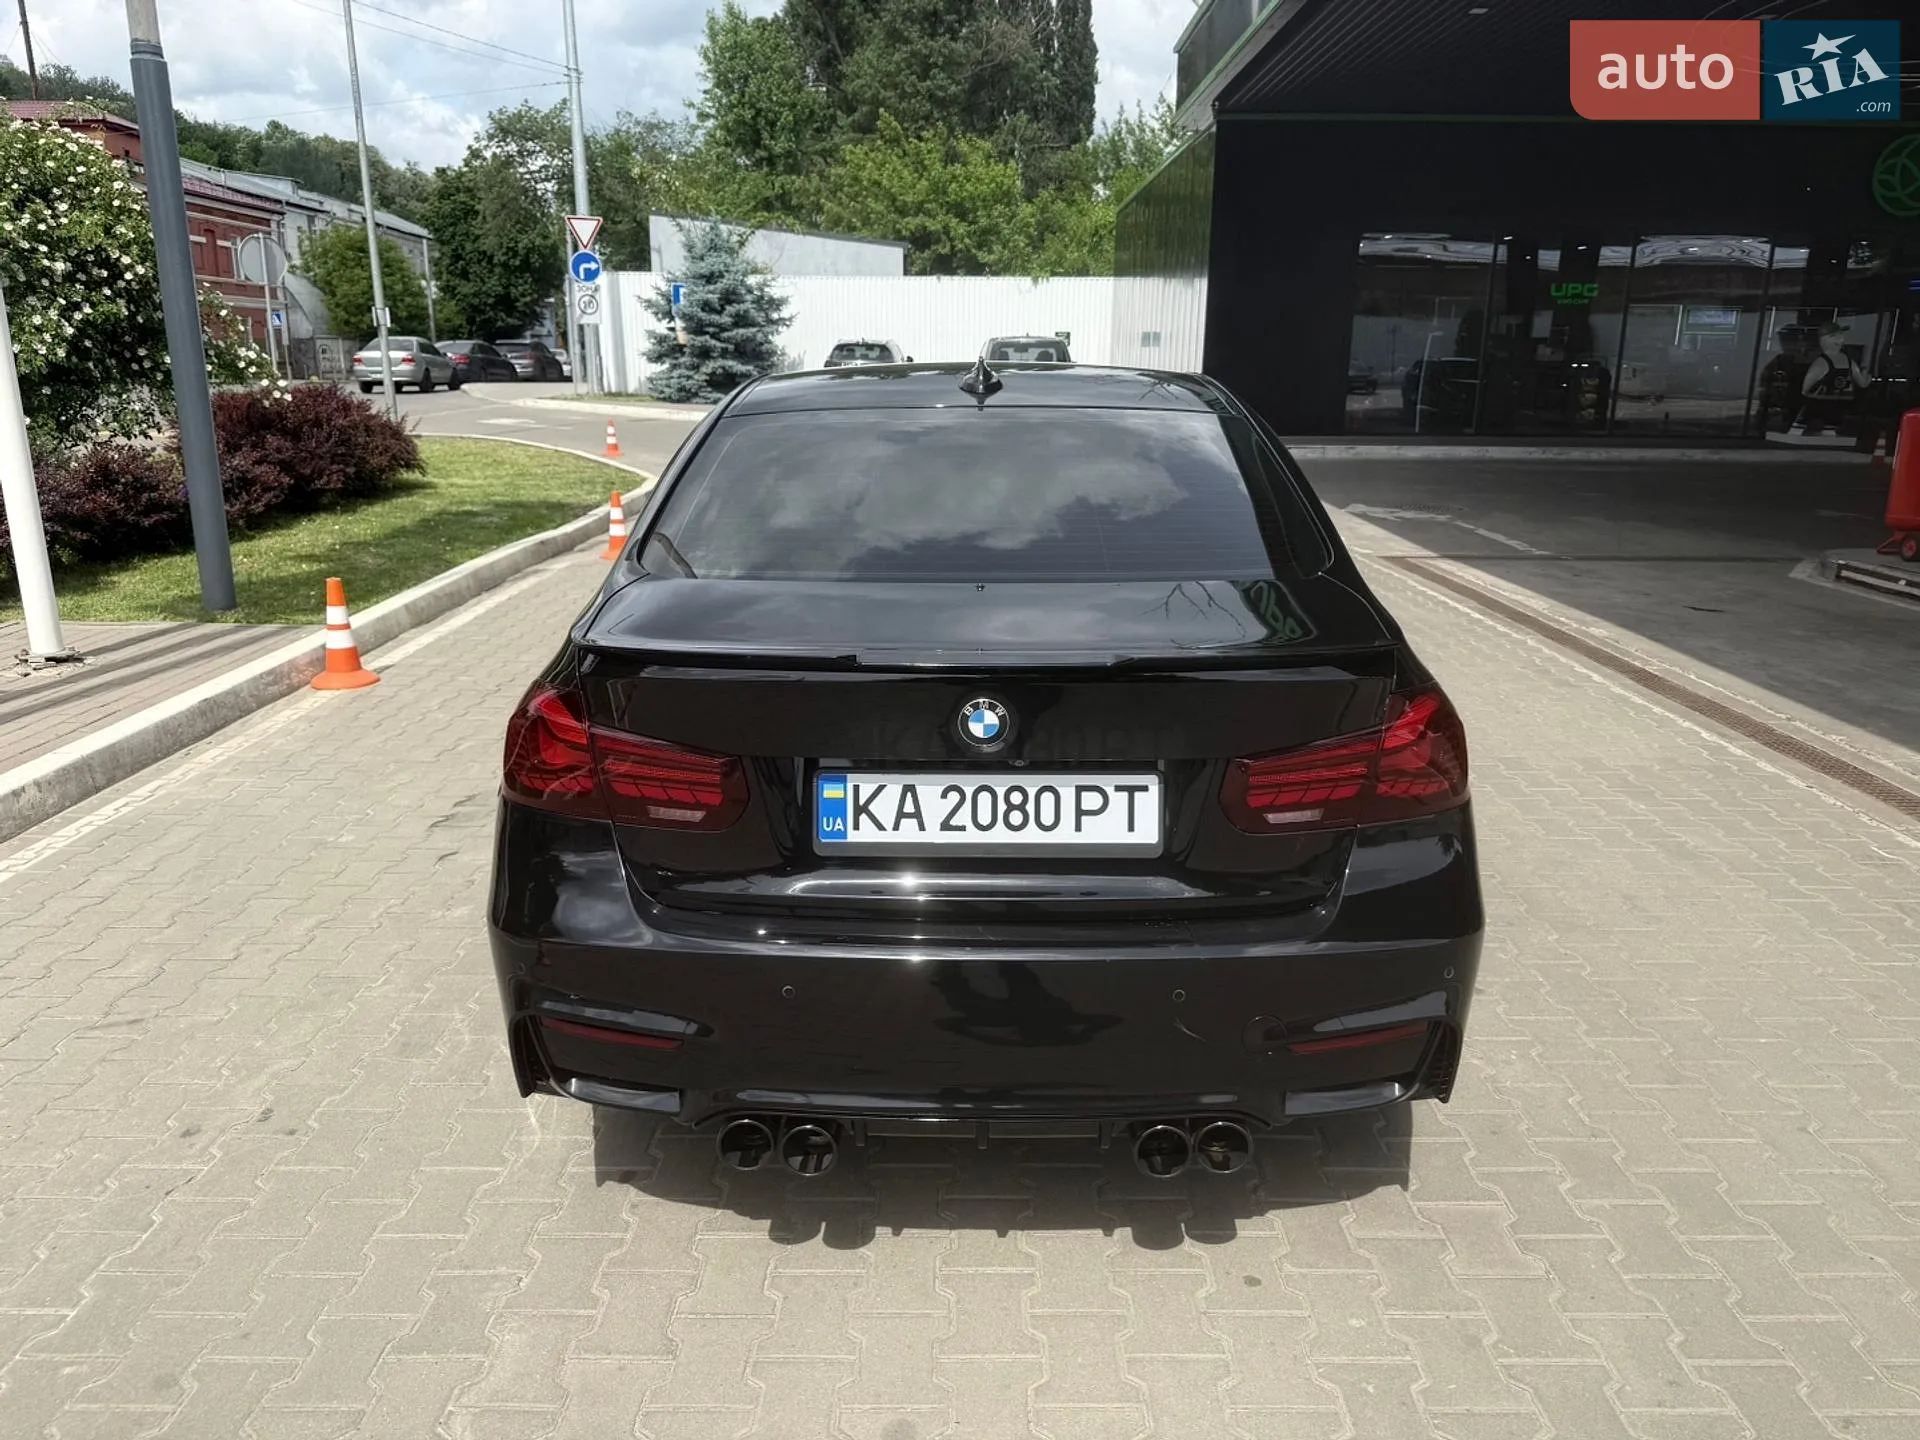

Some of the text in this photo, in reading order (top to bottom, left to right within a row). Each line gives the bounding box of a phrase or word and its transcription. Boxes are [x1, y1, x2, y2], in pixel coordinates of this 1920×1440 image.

[1551, 283, 1599, 297] UPG
[964, 700, 1007, 716] BMW
[852, 784, 1149, 832] KA 2080 PT
[823, 816, 845, 831] UA
